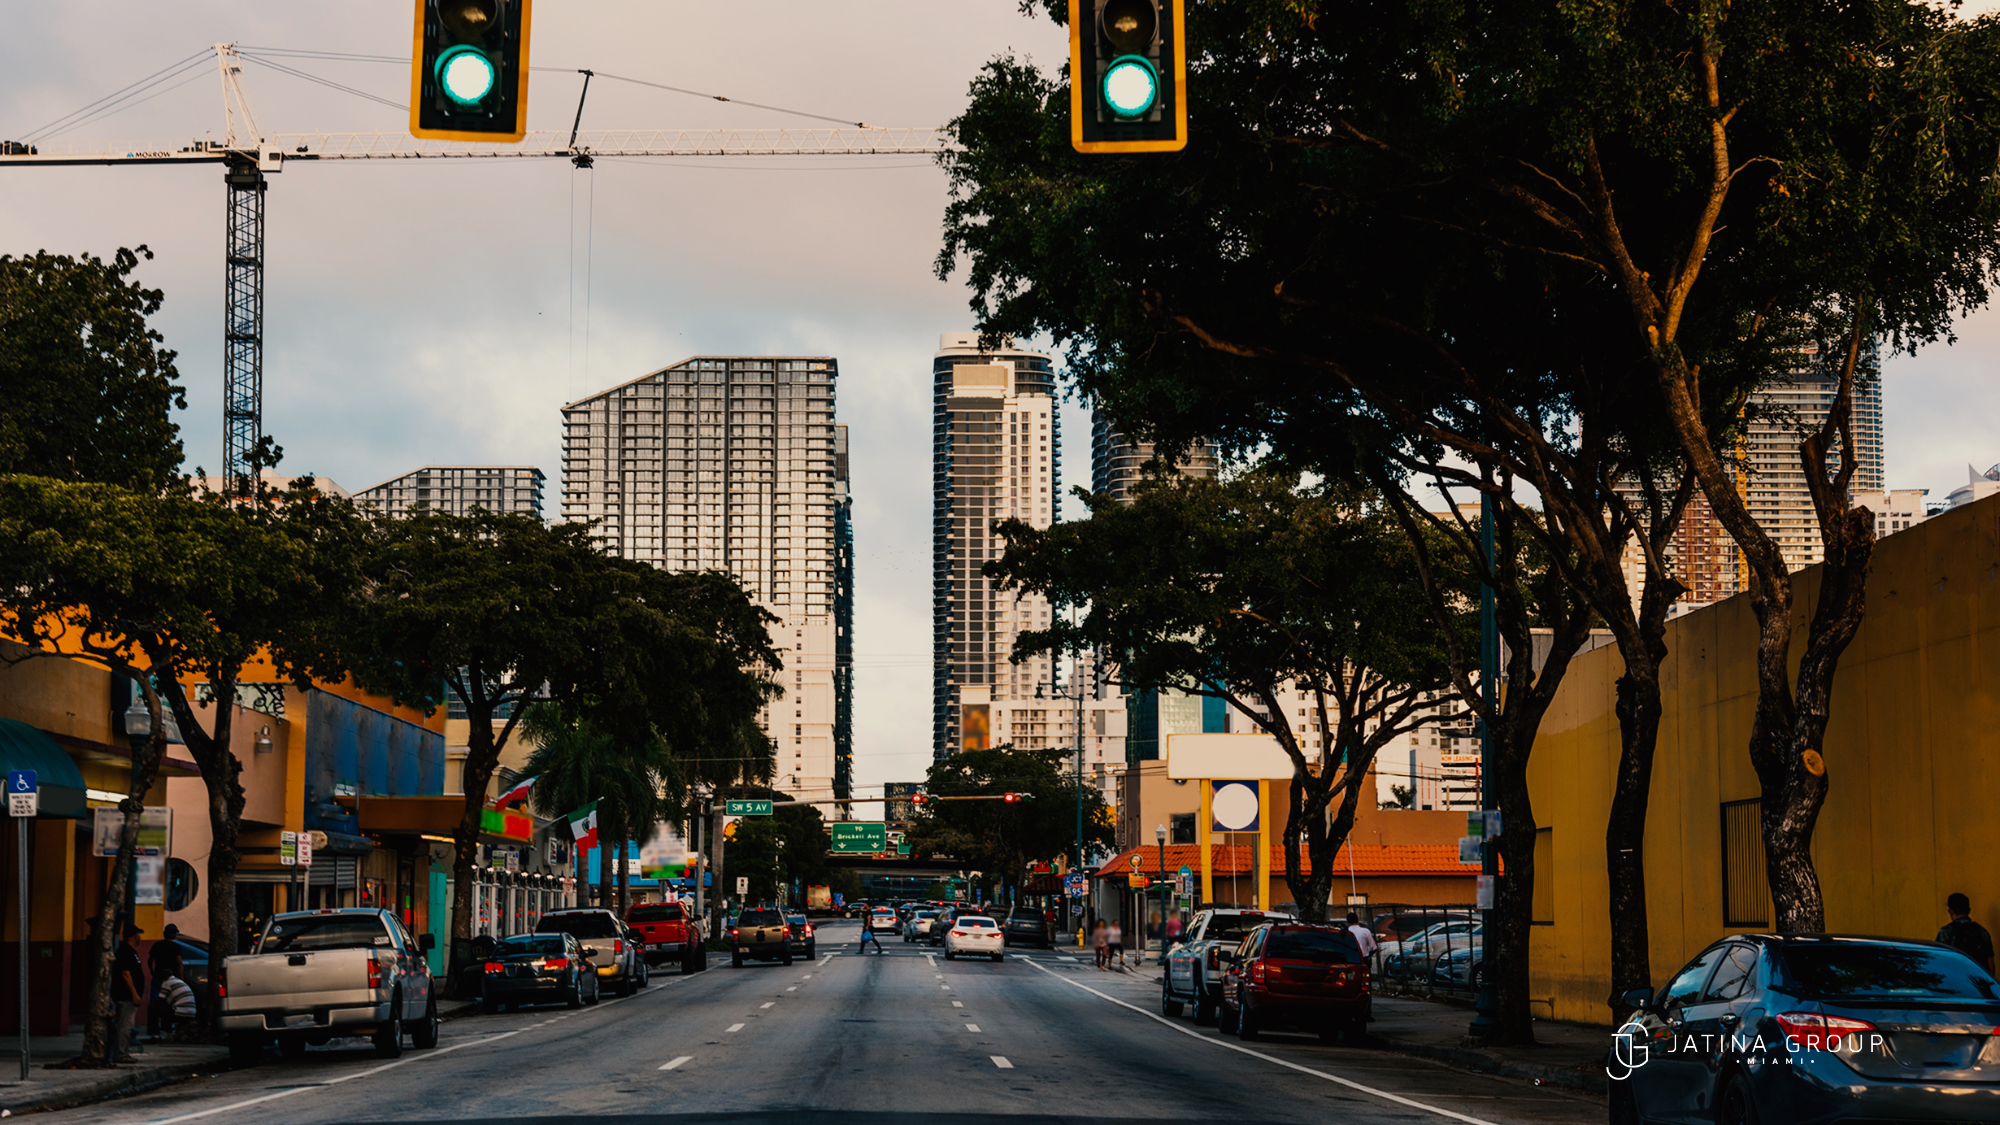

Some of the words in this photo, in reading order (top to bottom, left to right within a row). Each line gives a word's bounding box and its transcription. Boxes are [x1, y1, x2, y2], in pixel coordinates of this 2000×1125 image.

[732, 804, 743, 812] SW
[746, 803, 753, 813] 5
[755, 804, 767, 812] AV
[1071, 888, 1082, 897] 95
